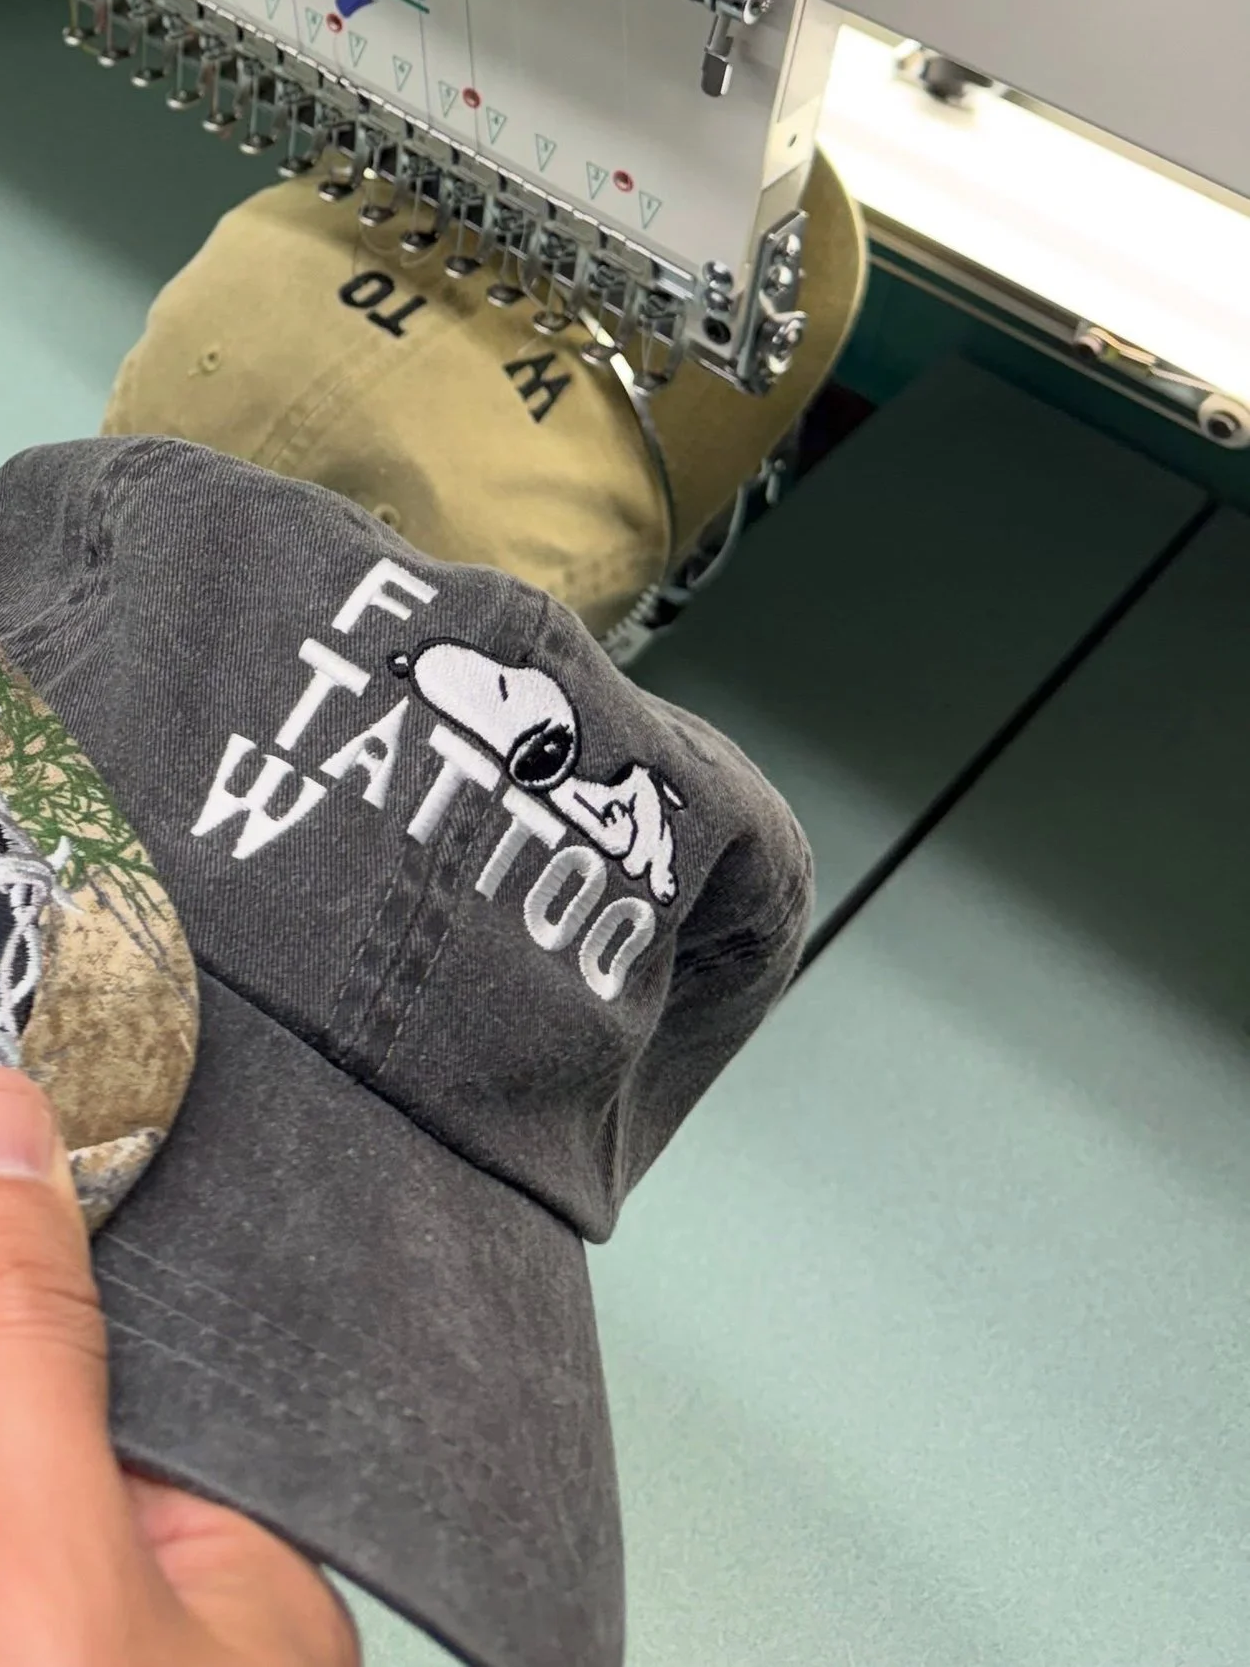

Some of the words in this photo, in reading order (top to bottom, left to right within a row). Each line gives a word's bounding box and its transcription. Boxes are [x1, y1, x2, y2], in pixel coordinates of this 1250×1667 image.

[332, 557, 438, 634] F
[190, 732, 327, 859] W
[275, 637, 655, 1001] TATTOO
